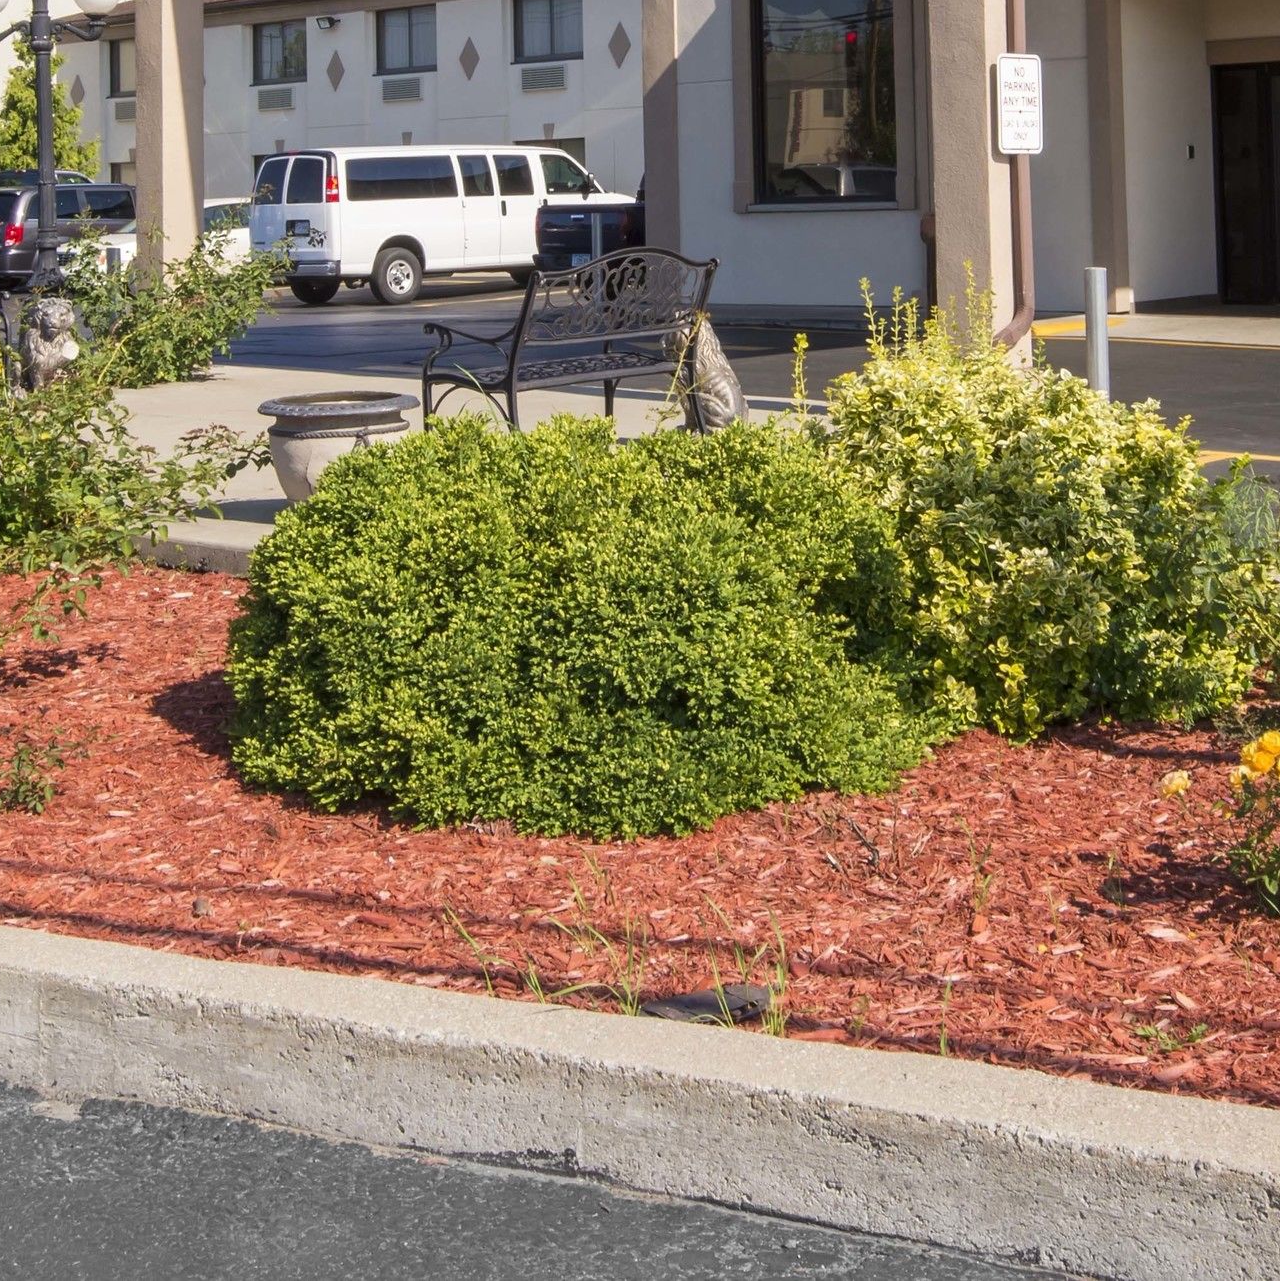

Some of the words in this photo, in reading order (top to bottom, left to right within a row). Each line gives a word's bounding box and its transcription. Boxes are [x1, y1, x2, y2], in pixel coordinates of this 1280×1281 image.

[1014, 66, 1025, 78] NO
[1003, 81, 1036, 93] PARKING
[1022, 97, 1038, 108] TIME
